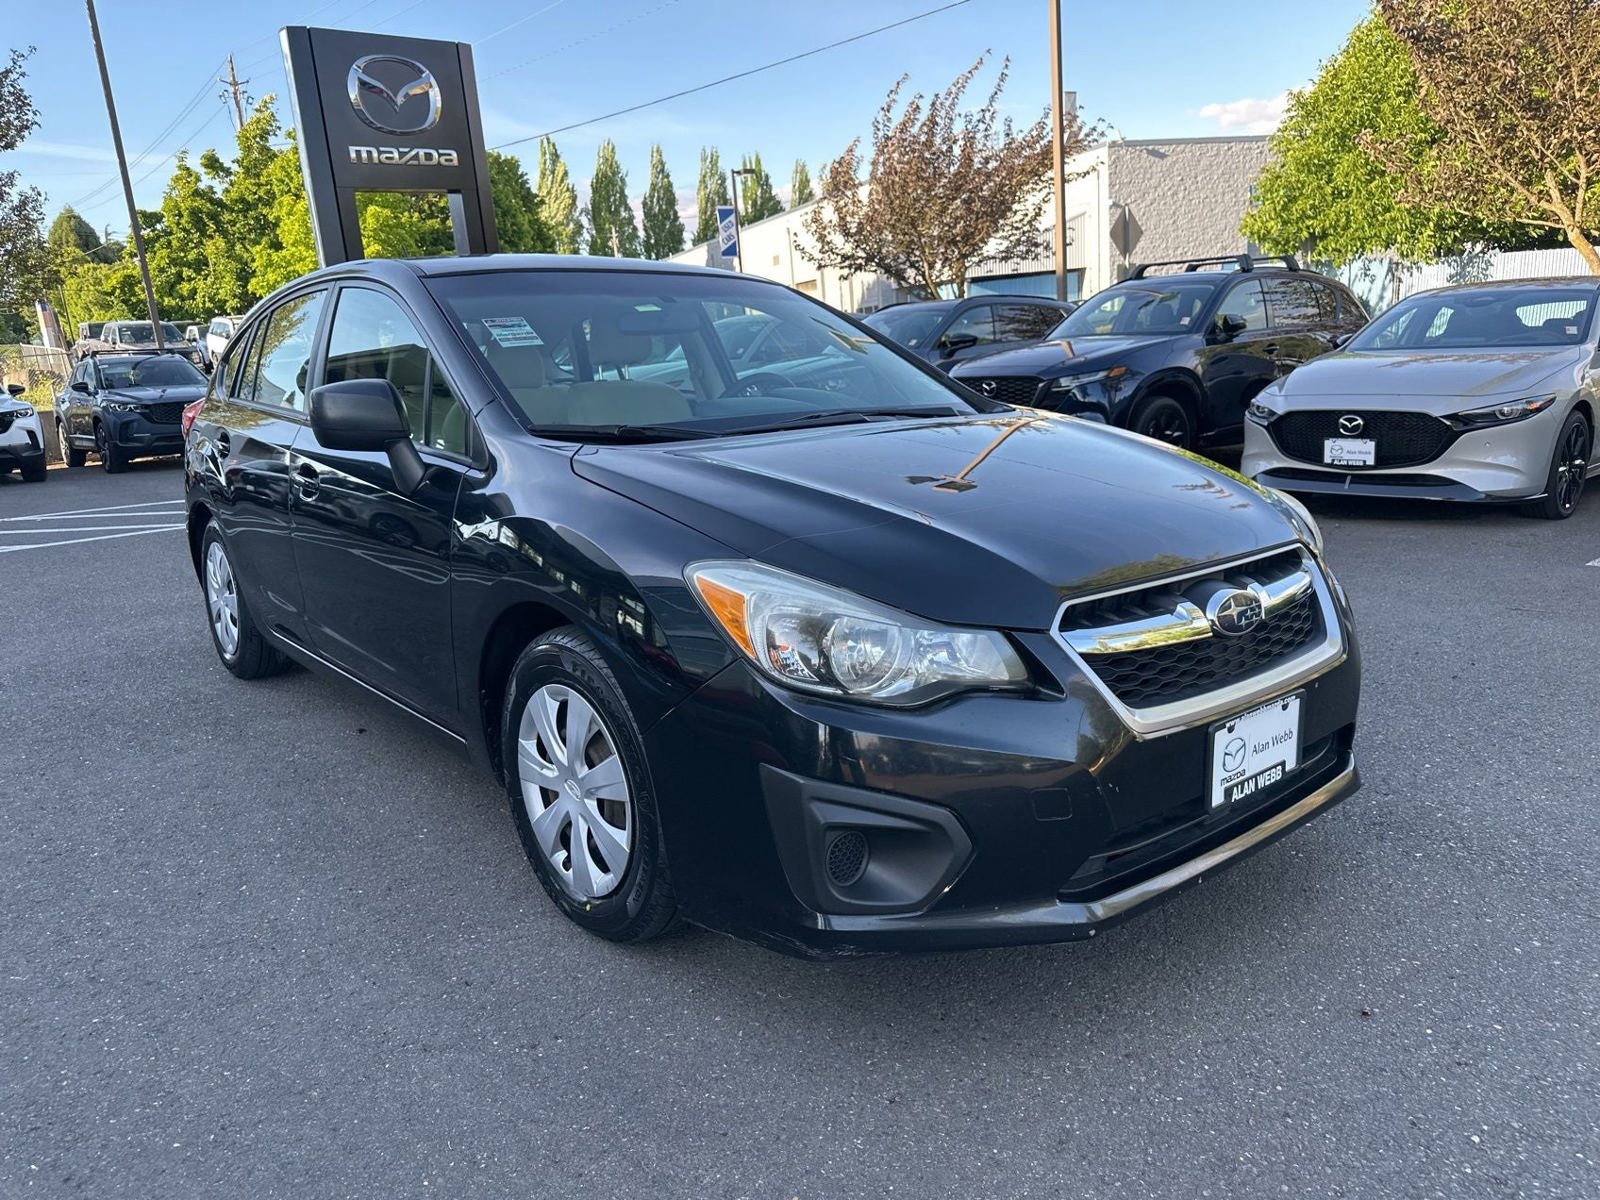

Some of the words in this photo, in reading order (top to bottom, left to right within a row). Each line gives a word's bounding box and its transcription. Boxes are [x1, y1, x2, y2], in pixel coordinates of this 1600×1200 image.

[1251, 742, 1270, 757] Alan
[1271, 728, 1294, 748] Webb
[1231, 778, 1256, 803] ALAN
[1257, 765, 1283, 790] WEBB
